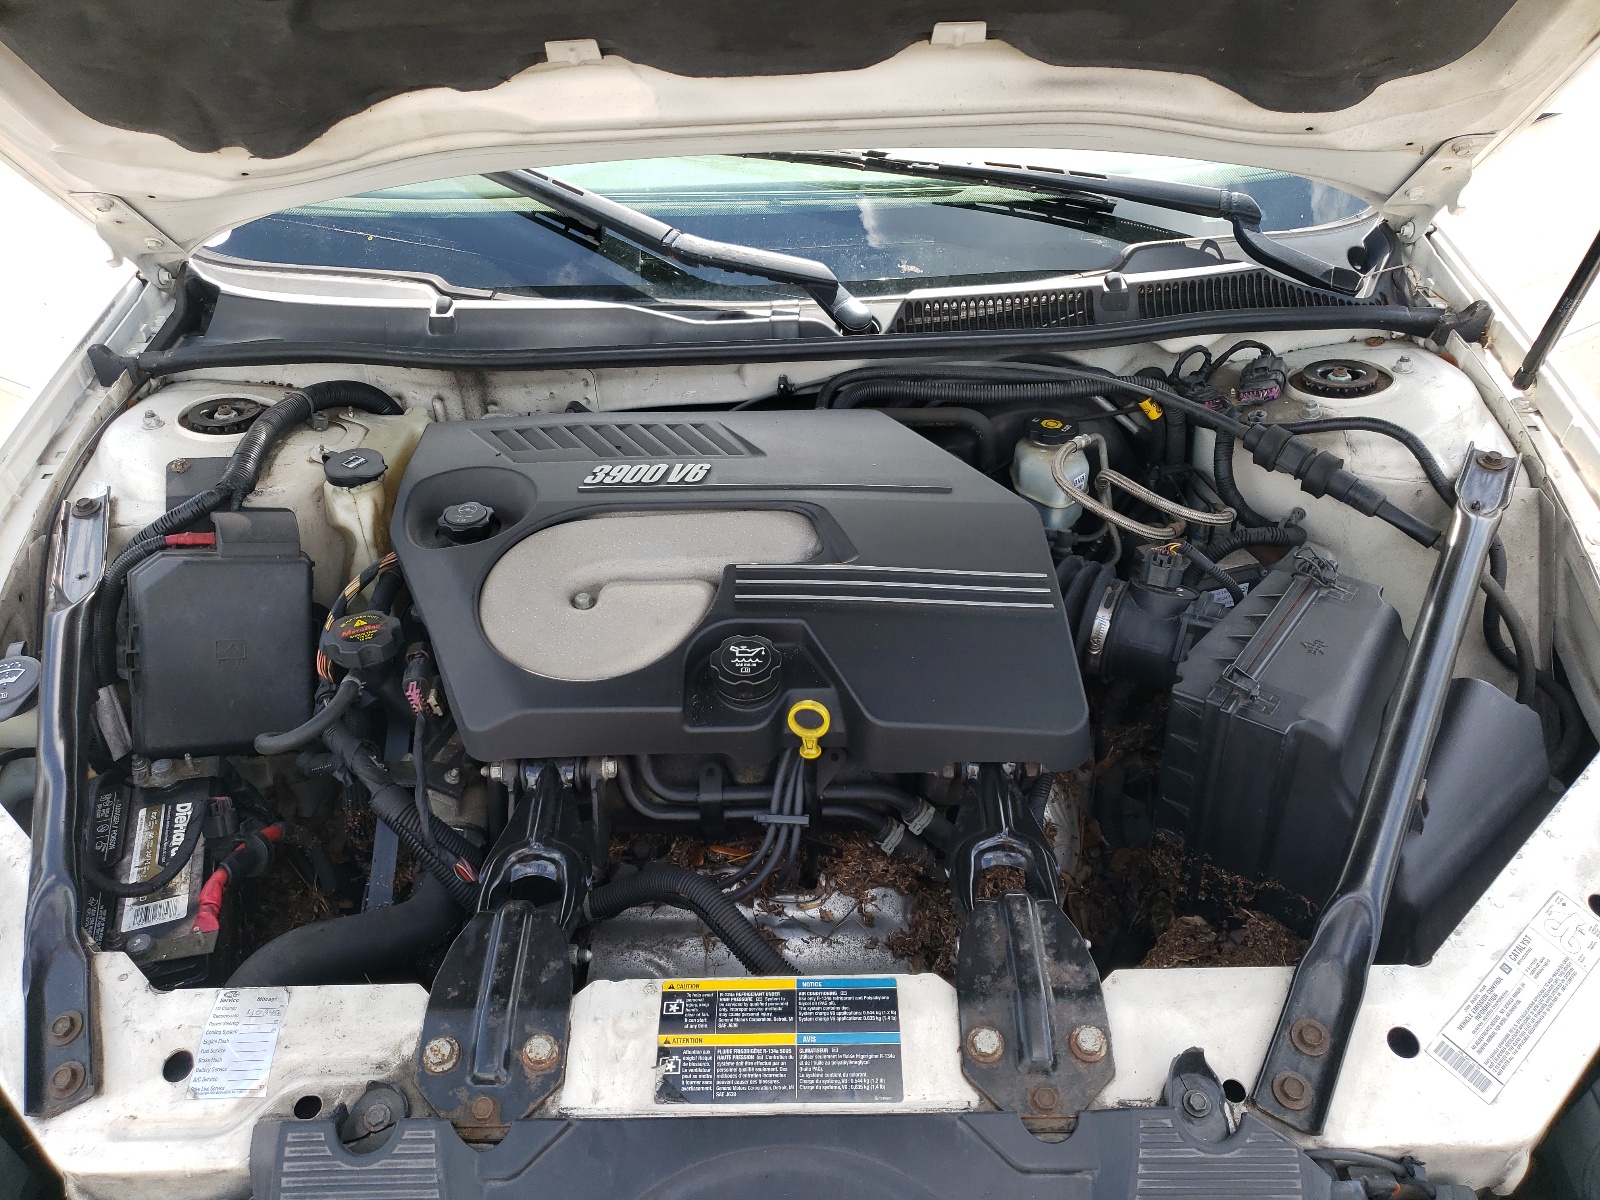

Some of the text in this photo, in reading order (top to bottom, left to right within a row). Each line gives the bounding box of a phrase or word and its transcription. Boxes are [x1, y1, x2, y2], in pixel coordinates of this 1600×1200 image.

[583, 464, 712, 484] 3900 V6
[1508, 933, 1533, 962] CATALYST
[1456, 1012, 1473, 1031] VEHICLE
[1470, 992, 1489, 1014] EMISSION
[1485, 975, 1503, 995] CONTROL
[1473, 992, 1498, 1021] INFORMATION
